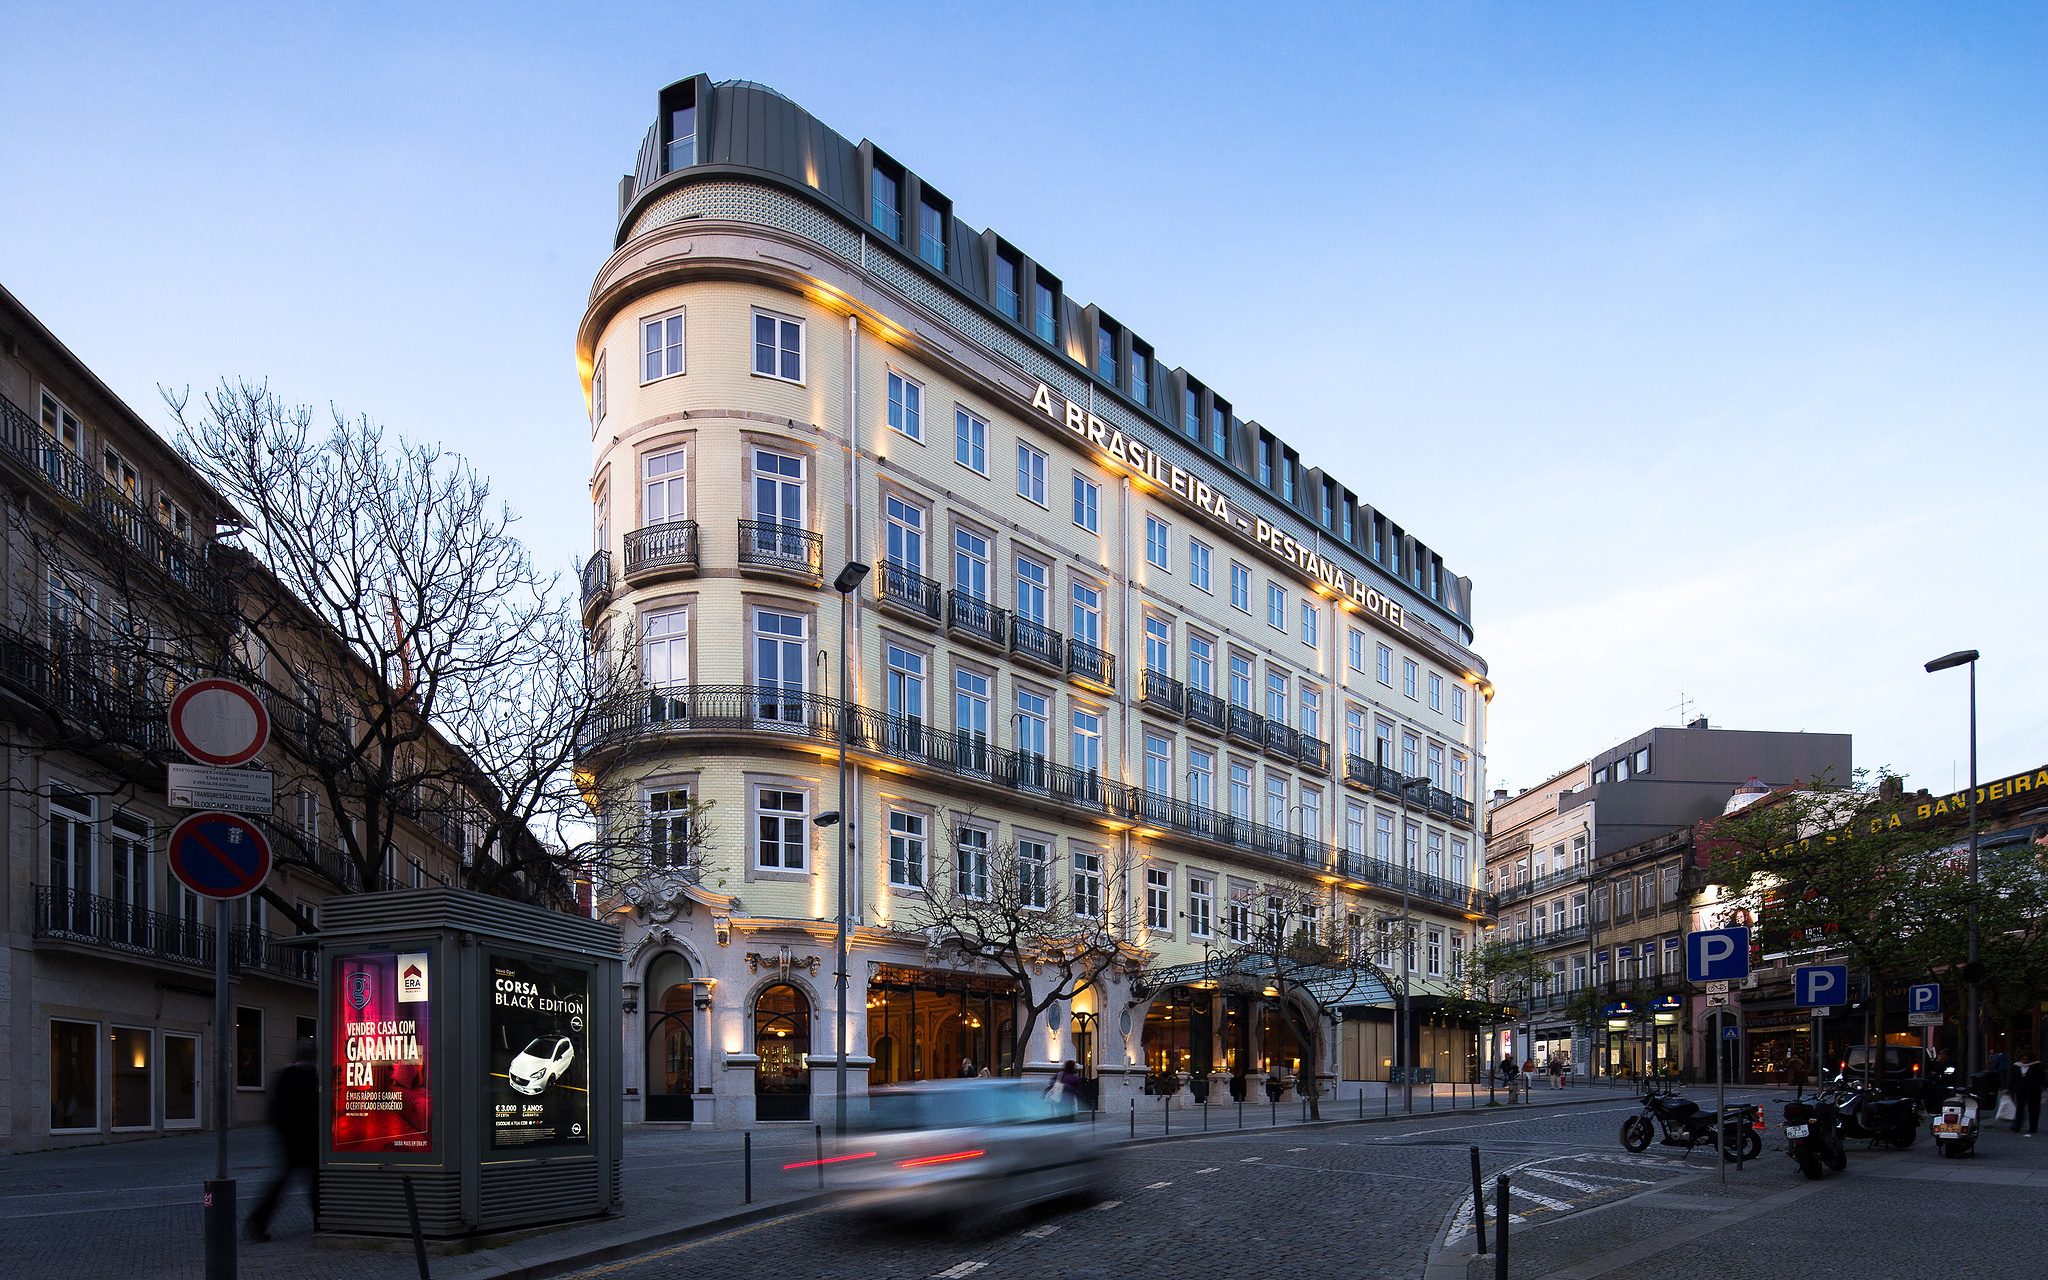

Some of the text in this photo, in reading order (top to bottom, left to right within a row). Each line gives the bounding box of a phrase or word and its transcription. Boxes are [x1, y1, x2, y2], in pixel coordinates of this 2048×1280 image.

[1031, 383, 1054, 418] A
[1065, 399, 1230, 524] BRASILEIRA
[1255, 517, 1347, 595] PESTANA
[1352, 578, 1410, 632] HOTEL
[219, 781, 249, 789] AUTORIZADOS
[194, 791, 232, 800] TRANSGRESSÃO
[256, 795, 271, 803] COIMA
[244, 804, 272, 814] REBOQUE
[1700, 934, 1735, 977] P
[405, 979, 421, 988] ERA
[495, 978, 539, 996] CORSA
[1807, 970, 1835, 1003] P
[495, 992, 584, 1015] BLACK EDITION
[1915, 987, 1933, 1011] P
[346, 1020, 416, 1036] VENDER CASA COM
[1745, 1015, 1788, 1027] CUTELARIAS
[346, 1035, 419, 1061] GARANTIA
[346, 1061, 374, 1087] ERA
[346, 1090, 403, 1100] É MAIS RÁPIDO E GARANTE
[345, 1100, 403, 1111] O CERTIFICADO ENERGÉTICO
[495, 1104, 517, 1112] € 3.000
[522, 1104, 543, 1112] 5 ANOS
